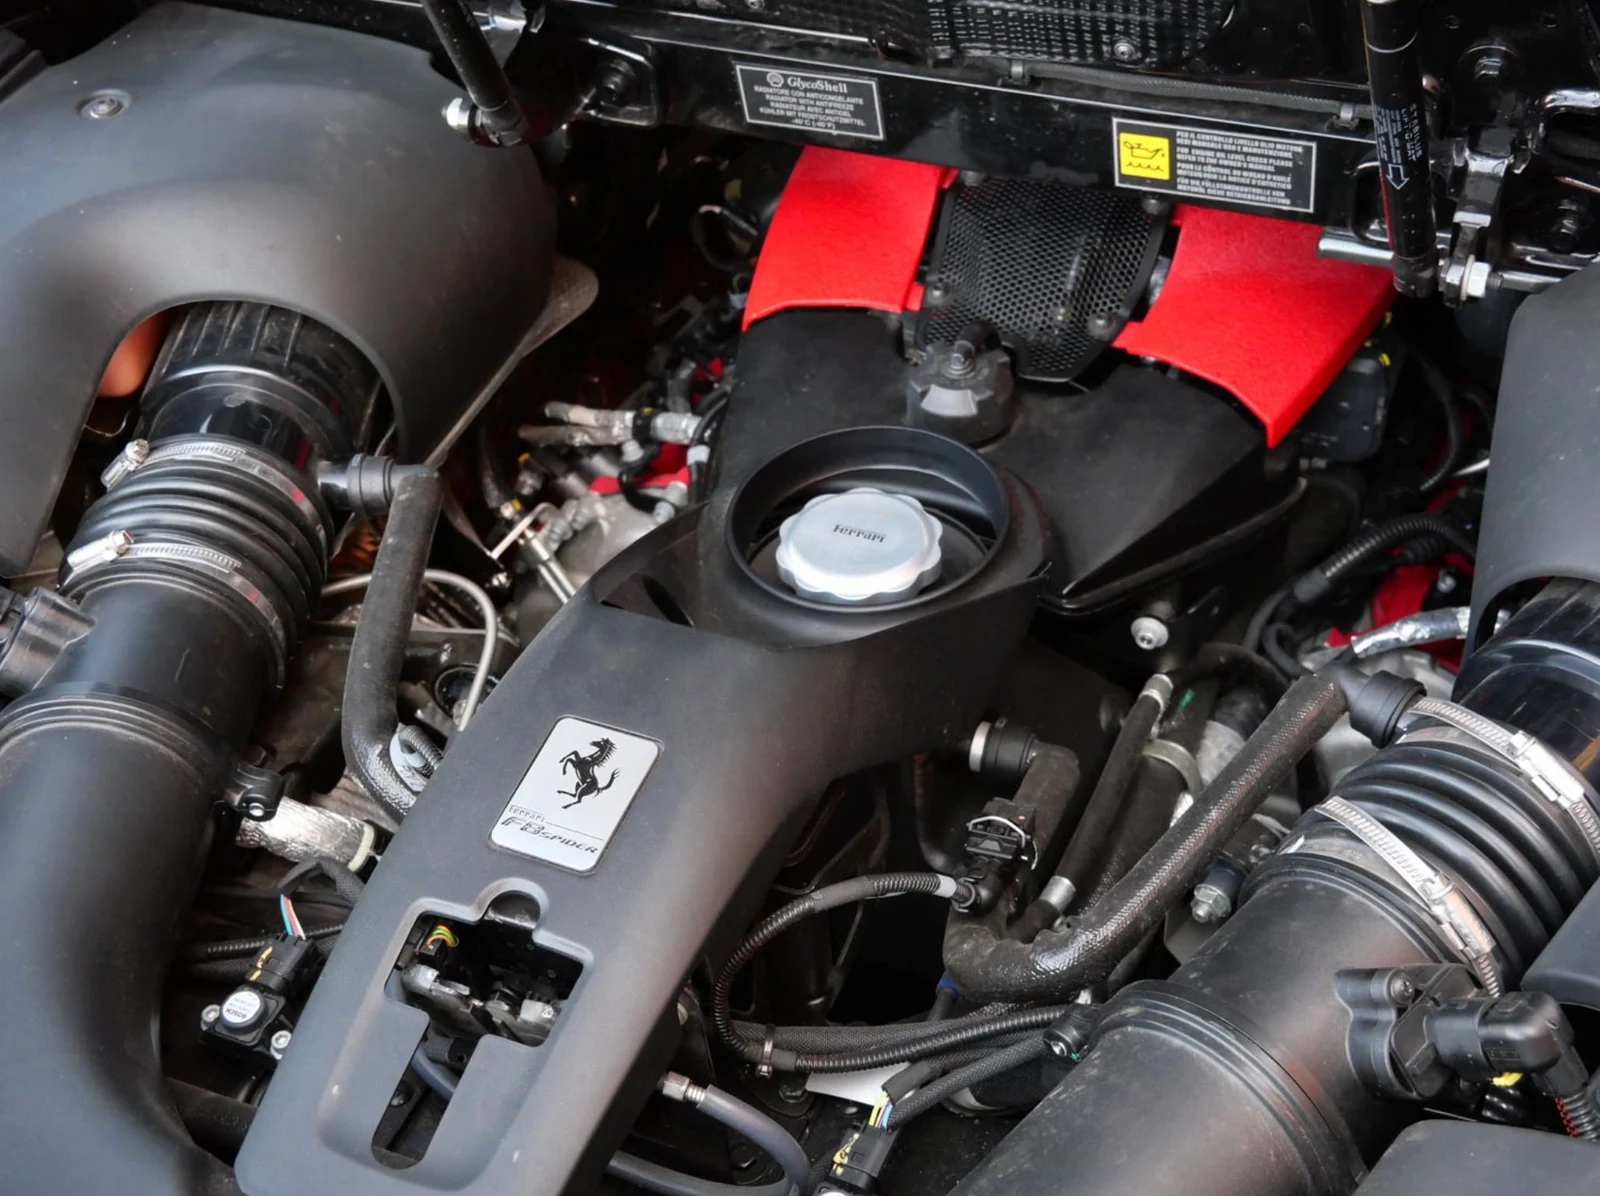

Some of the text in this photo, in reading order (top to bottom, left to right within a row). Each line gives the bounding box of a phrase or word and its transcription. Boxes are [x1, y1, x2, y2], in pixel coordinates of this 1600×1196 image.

[787, 77, 848, 93] GlycoShell
[765, 94, 798, 104] RADIATOR
[798, 98, 815, 106] WITH
[807, 106, 824, 114] AVEC
[1177, 138, 1191, 146] VEDI
[1192, 140, 1222, 149] MANUALE
[1197, 134, 1233, 144] CONTROLLO
[1234, 138, 1259, 147] LIVELLO
[1260, 141, 1275, 149] OLIO
[1177, 153, 1196, 161] REFER
[1219, 159, 1247, 168] OWNER'S
[1192, 148, 1215, 157] ENGINE
[1227, 153, 1245, 161] LEVEL
[1246, 155, 1268, 164] CHECK
[1269, 158, 1293, 167] PLEASE
[1177, 162, 1194, 170] POUR
[833, 524, 885, 543] Ferrari
[508, 804, 546, 822] Ferrari
[500, 816, 598, 854] F8 SPIDER
